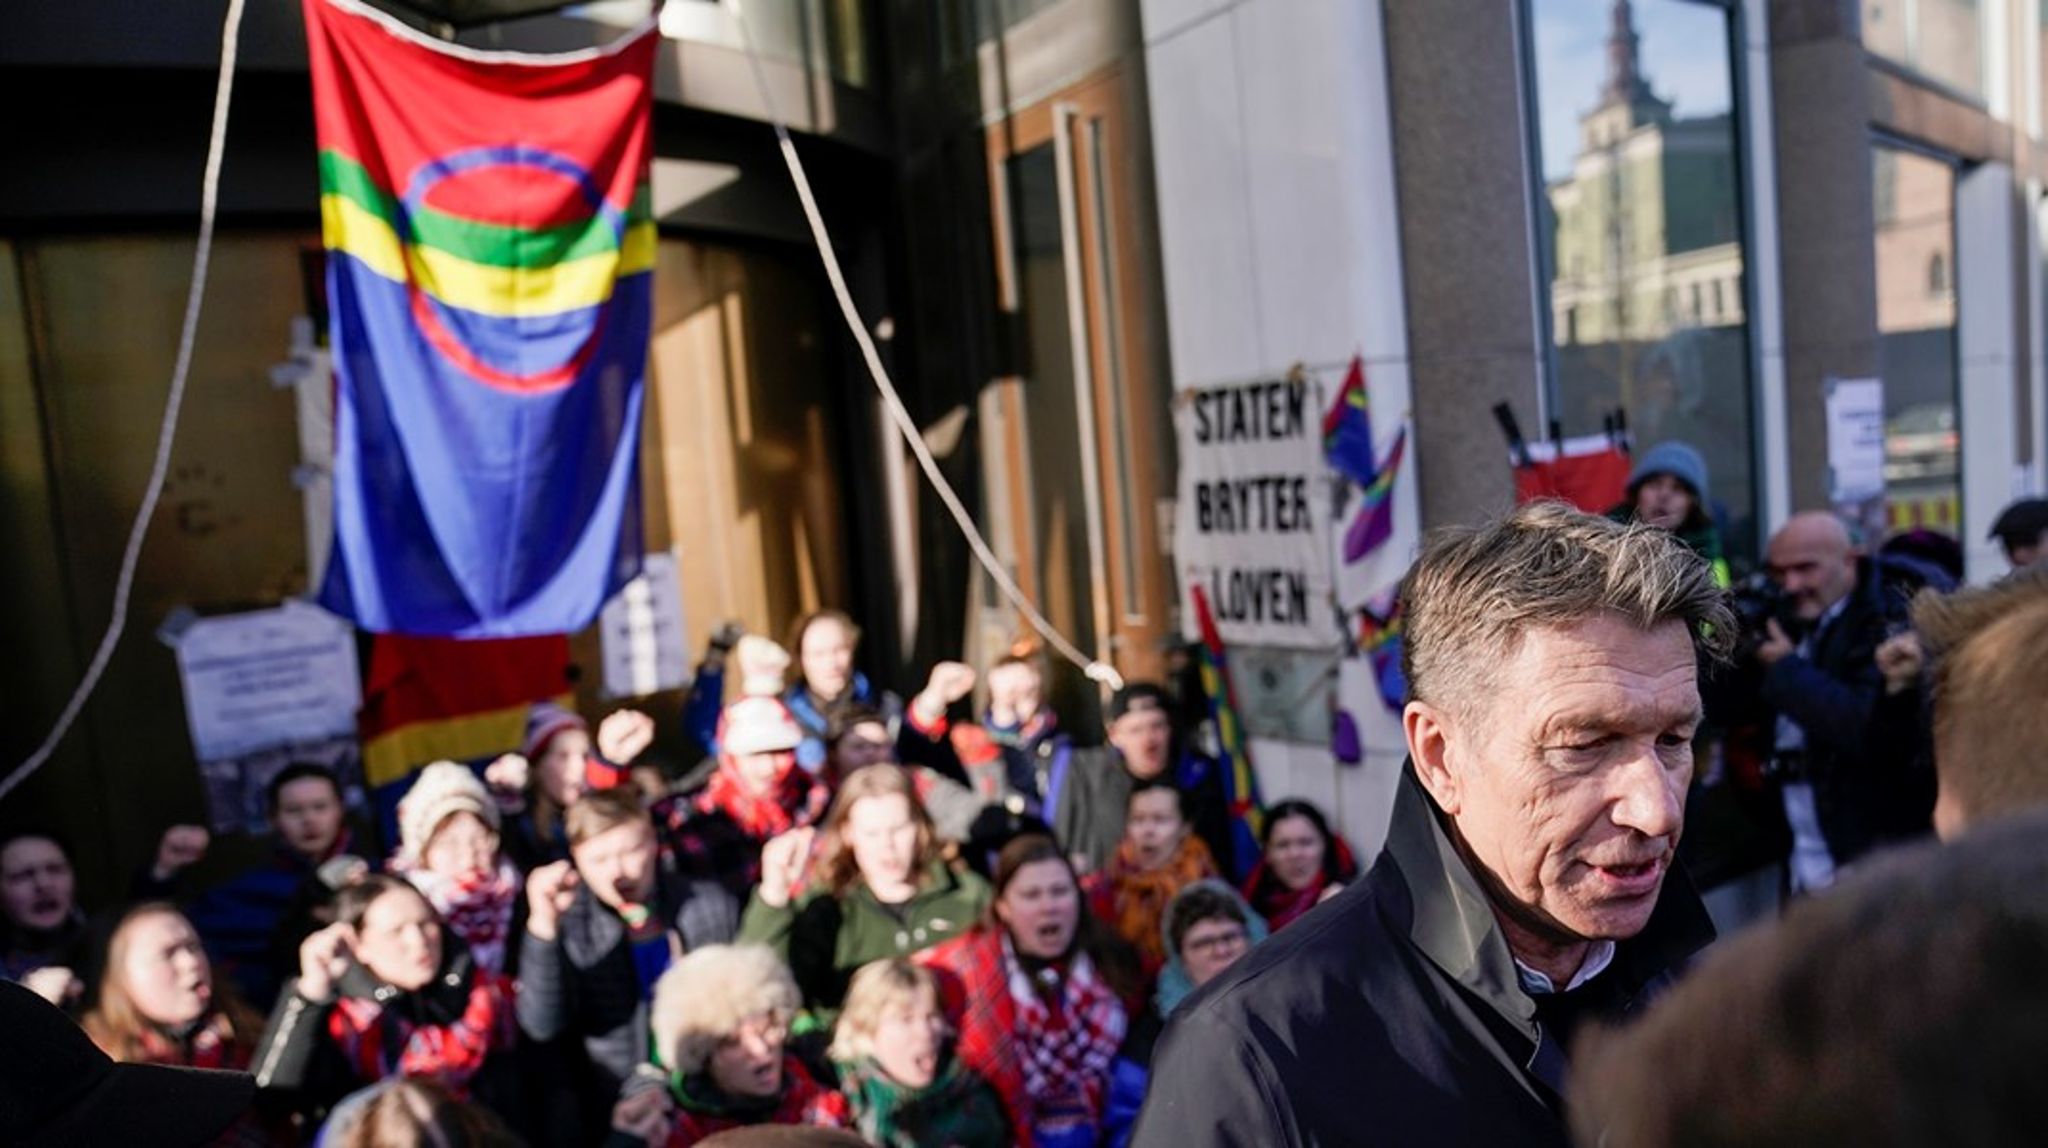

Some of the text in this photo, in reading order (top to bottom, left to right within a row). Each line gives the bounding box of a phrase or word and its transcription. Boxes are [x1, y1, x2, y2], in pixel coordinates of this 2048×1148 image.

[1195, 382, 1305, 443] STATEN
[1197, 477, 1311, 534] BRYTER
[1212, 567, 1309, 624] LOVEN
